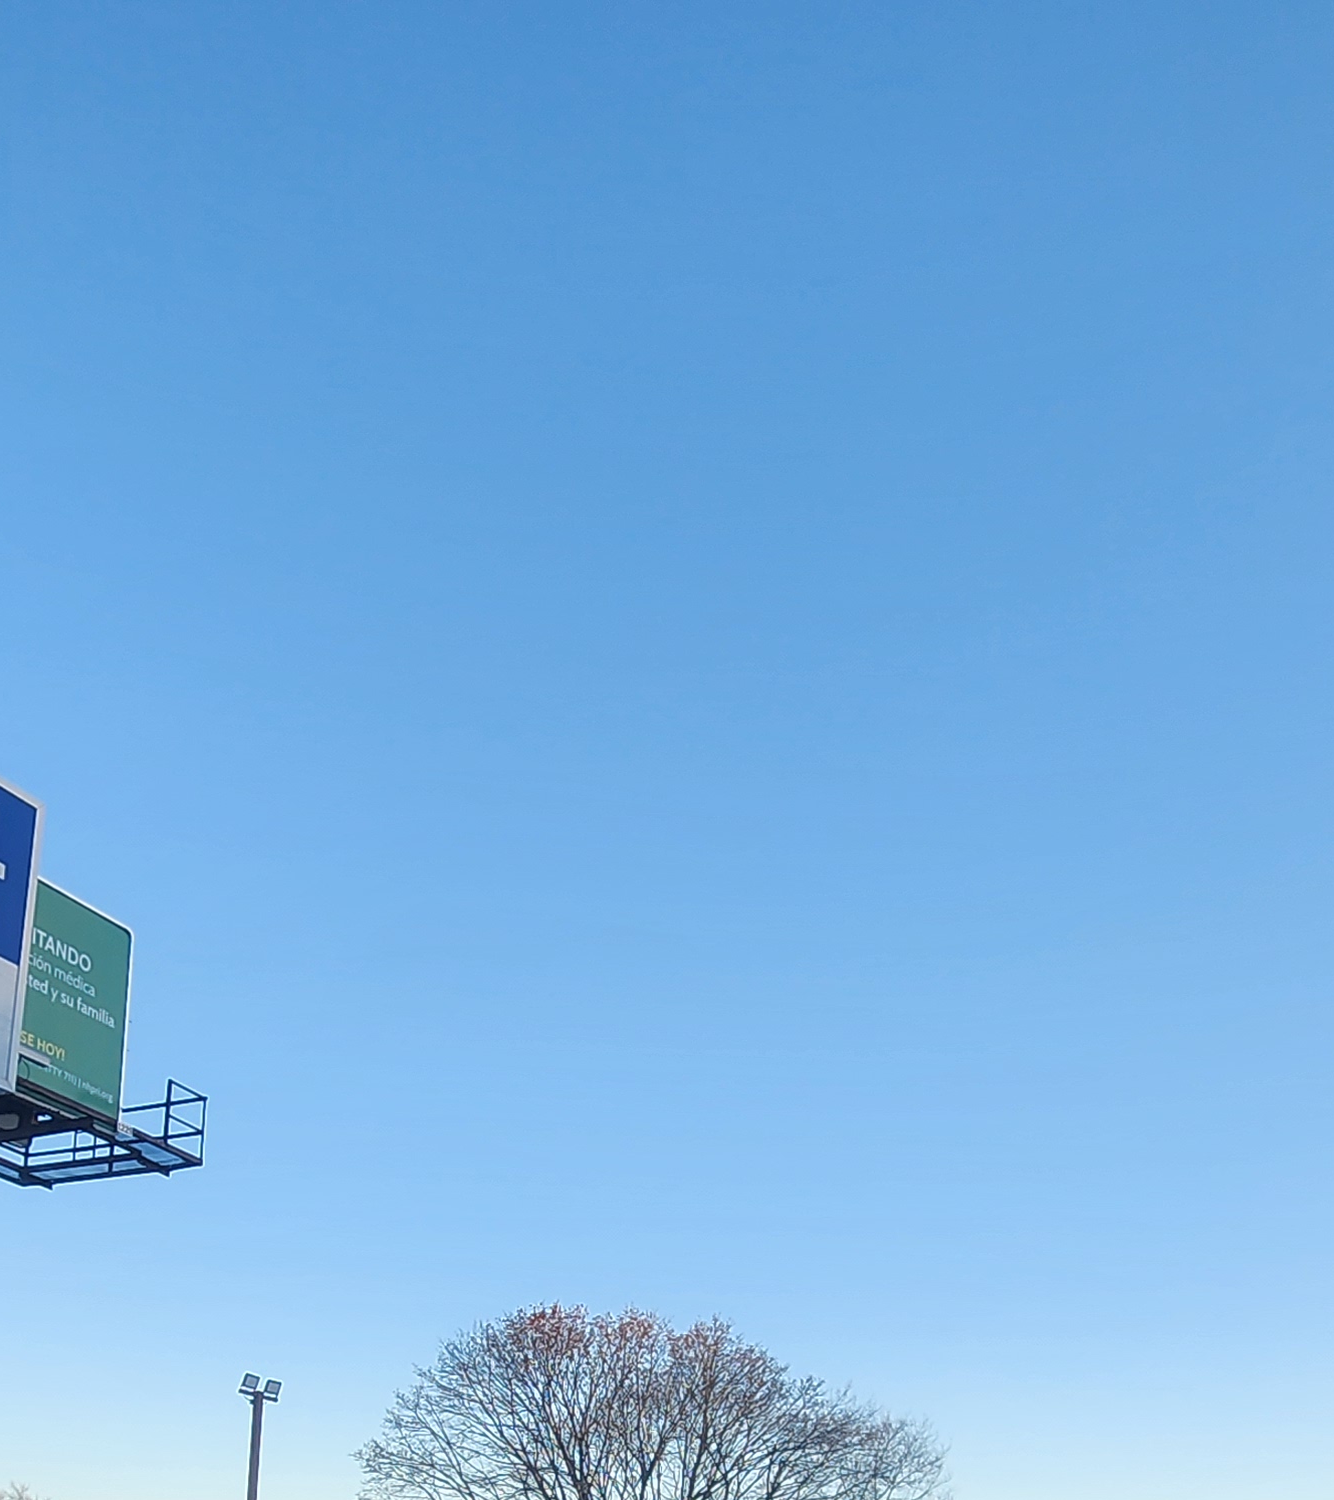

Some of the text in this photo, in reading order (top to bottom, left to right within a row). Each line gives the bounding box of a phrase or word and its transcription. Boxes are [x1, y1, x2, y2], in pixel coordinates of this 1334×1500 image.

[32, 927, 91, 972] ITANDO
[54, 967, 96, 997] médica
[27, 974, 115, 1029] ted y su familia
[37, 1037, 65, 1061] HOY!
